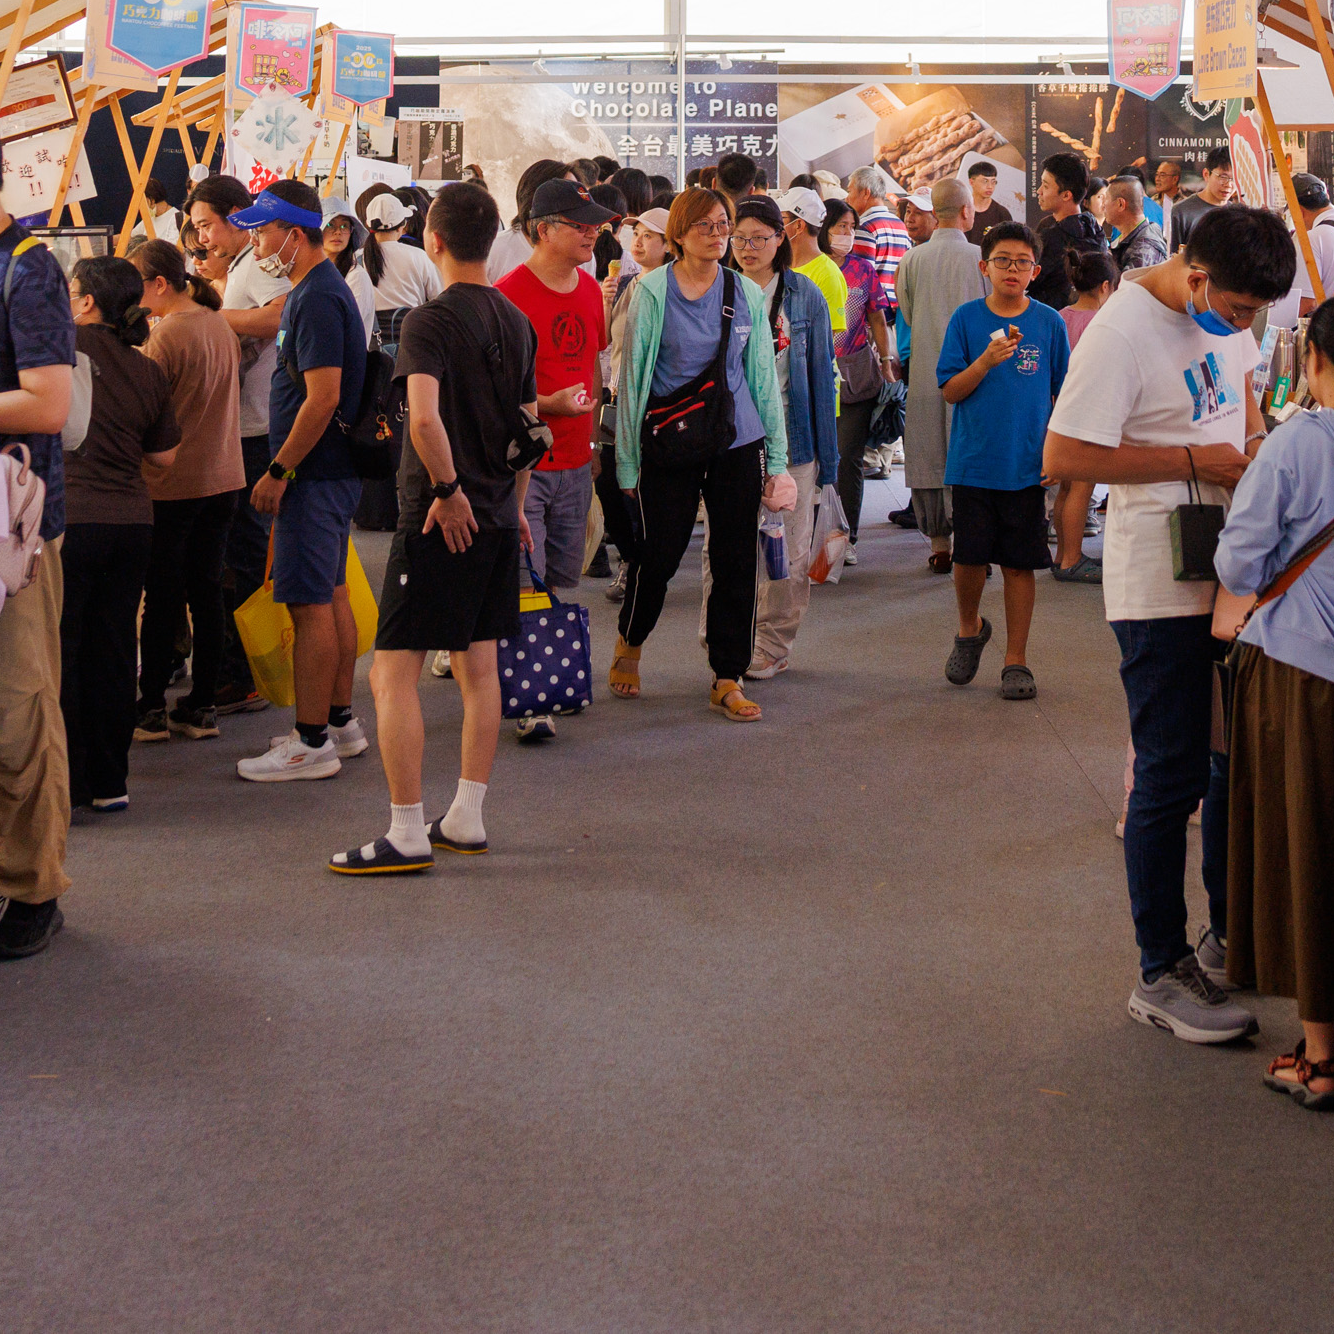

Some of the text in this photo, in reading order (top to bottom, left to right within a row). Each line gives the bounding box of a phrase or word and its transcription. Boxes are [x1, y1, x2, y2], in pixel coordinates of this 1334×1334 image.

[122, 4, 198, 23] 巧克力咖啡節
[572, 81, 716, 94] Welcome to
[570, 99, 698, 117] Chocolae
[255, 106, 301, 151] 冰
[618, 134, 778, 157] 全台最美巧克力
[1159, 138, 1212, 147] CINNAMON
[1184, 151, 1208, 162] 肉桂
